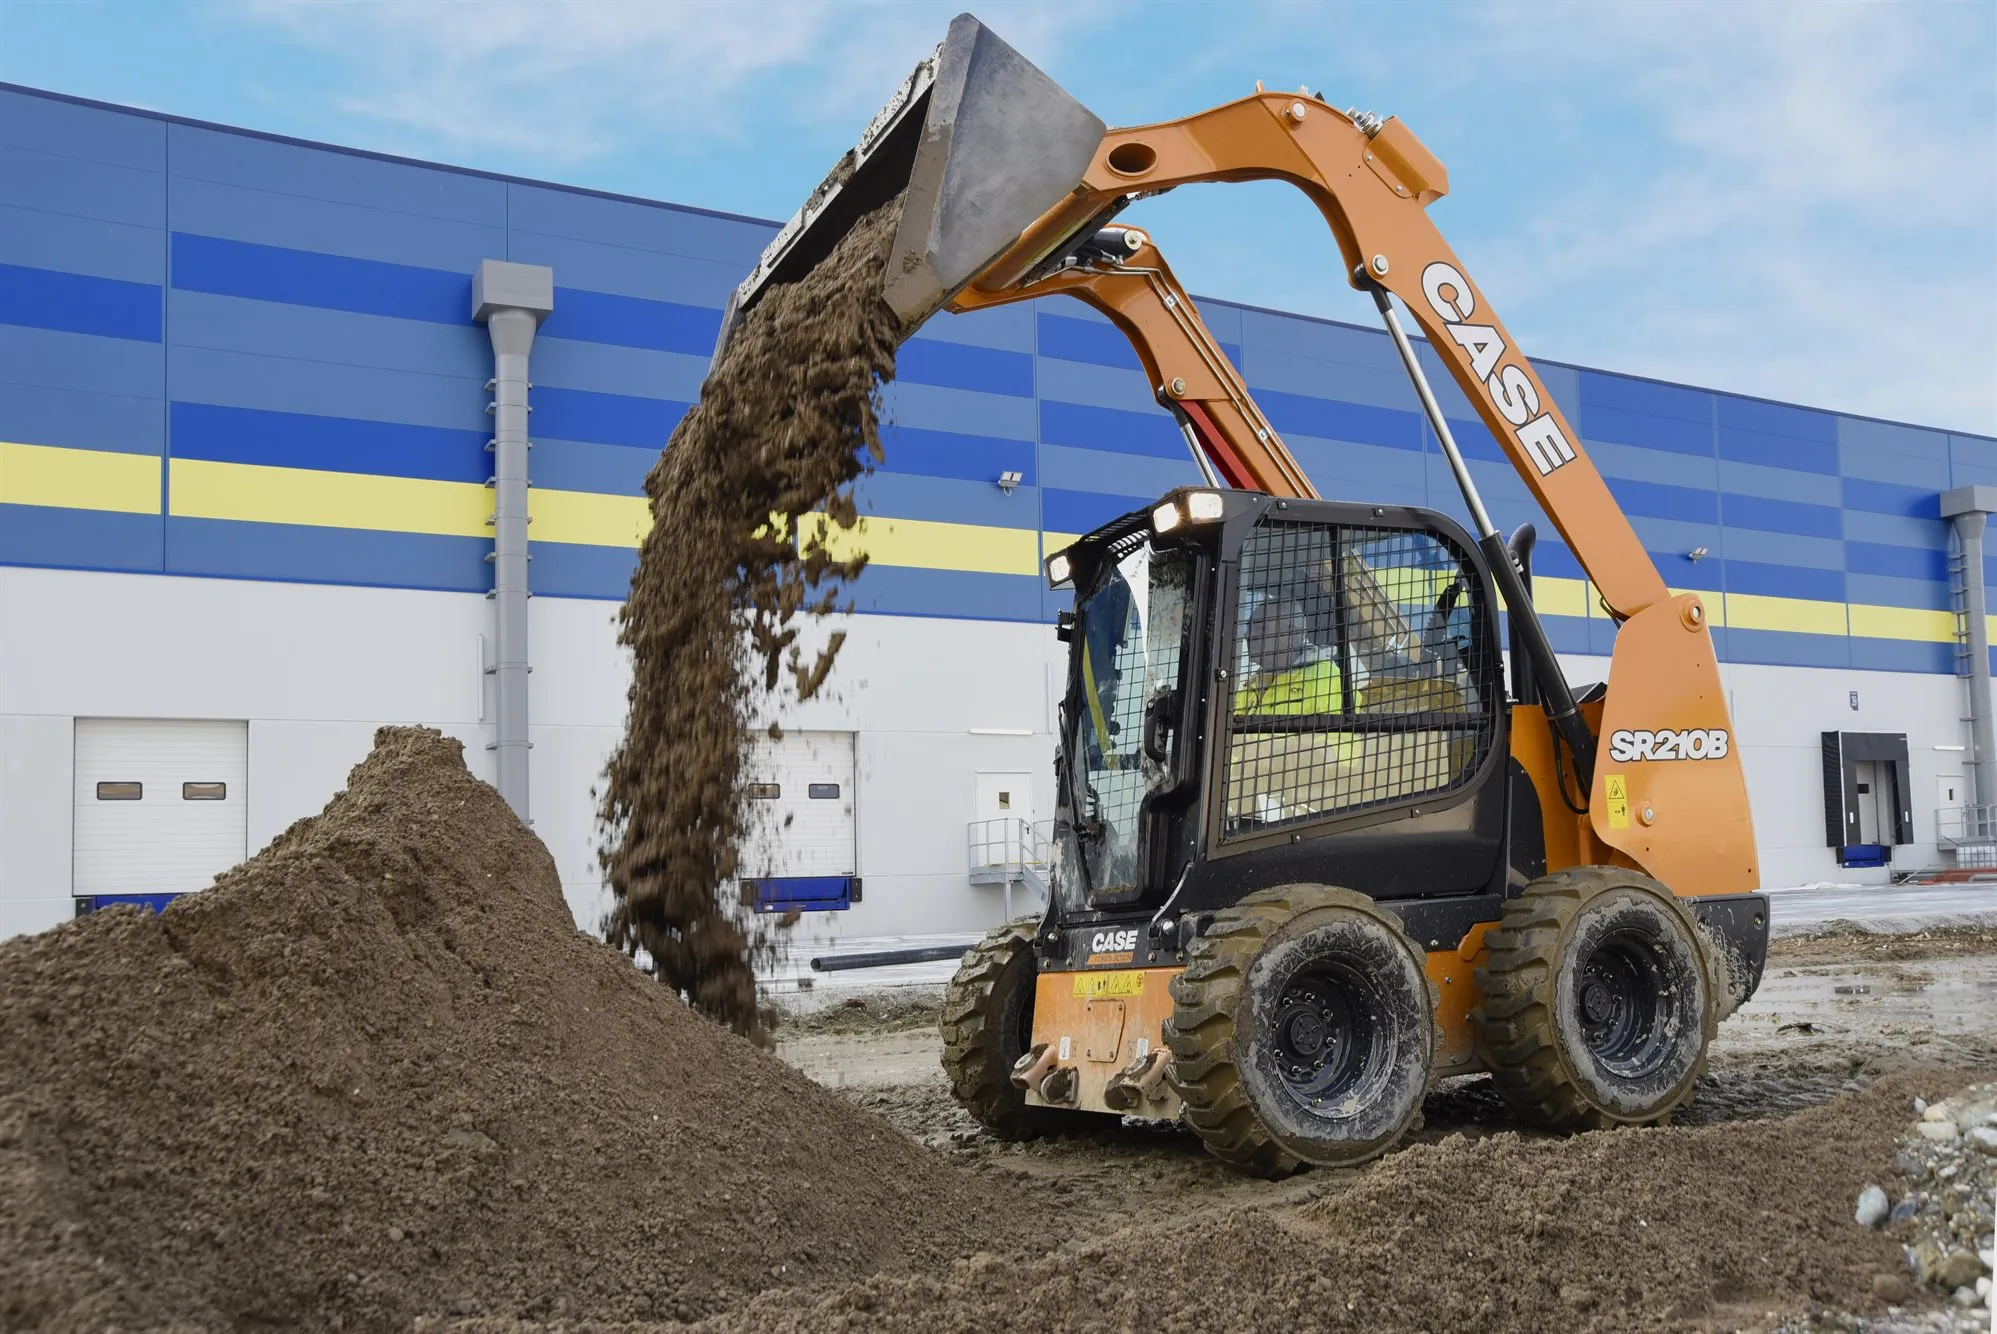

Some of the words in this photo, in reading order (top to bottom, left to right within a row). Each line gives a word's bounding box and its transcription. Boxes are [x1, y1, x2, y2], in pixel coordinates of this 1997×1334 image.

[1421, 262, 1577, 476] CASE
[1610, 729, 1728, 762] SR210B
[1092, 930, 1138, 953] CASE
